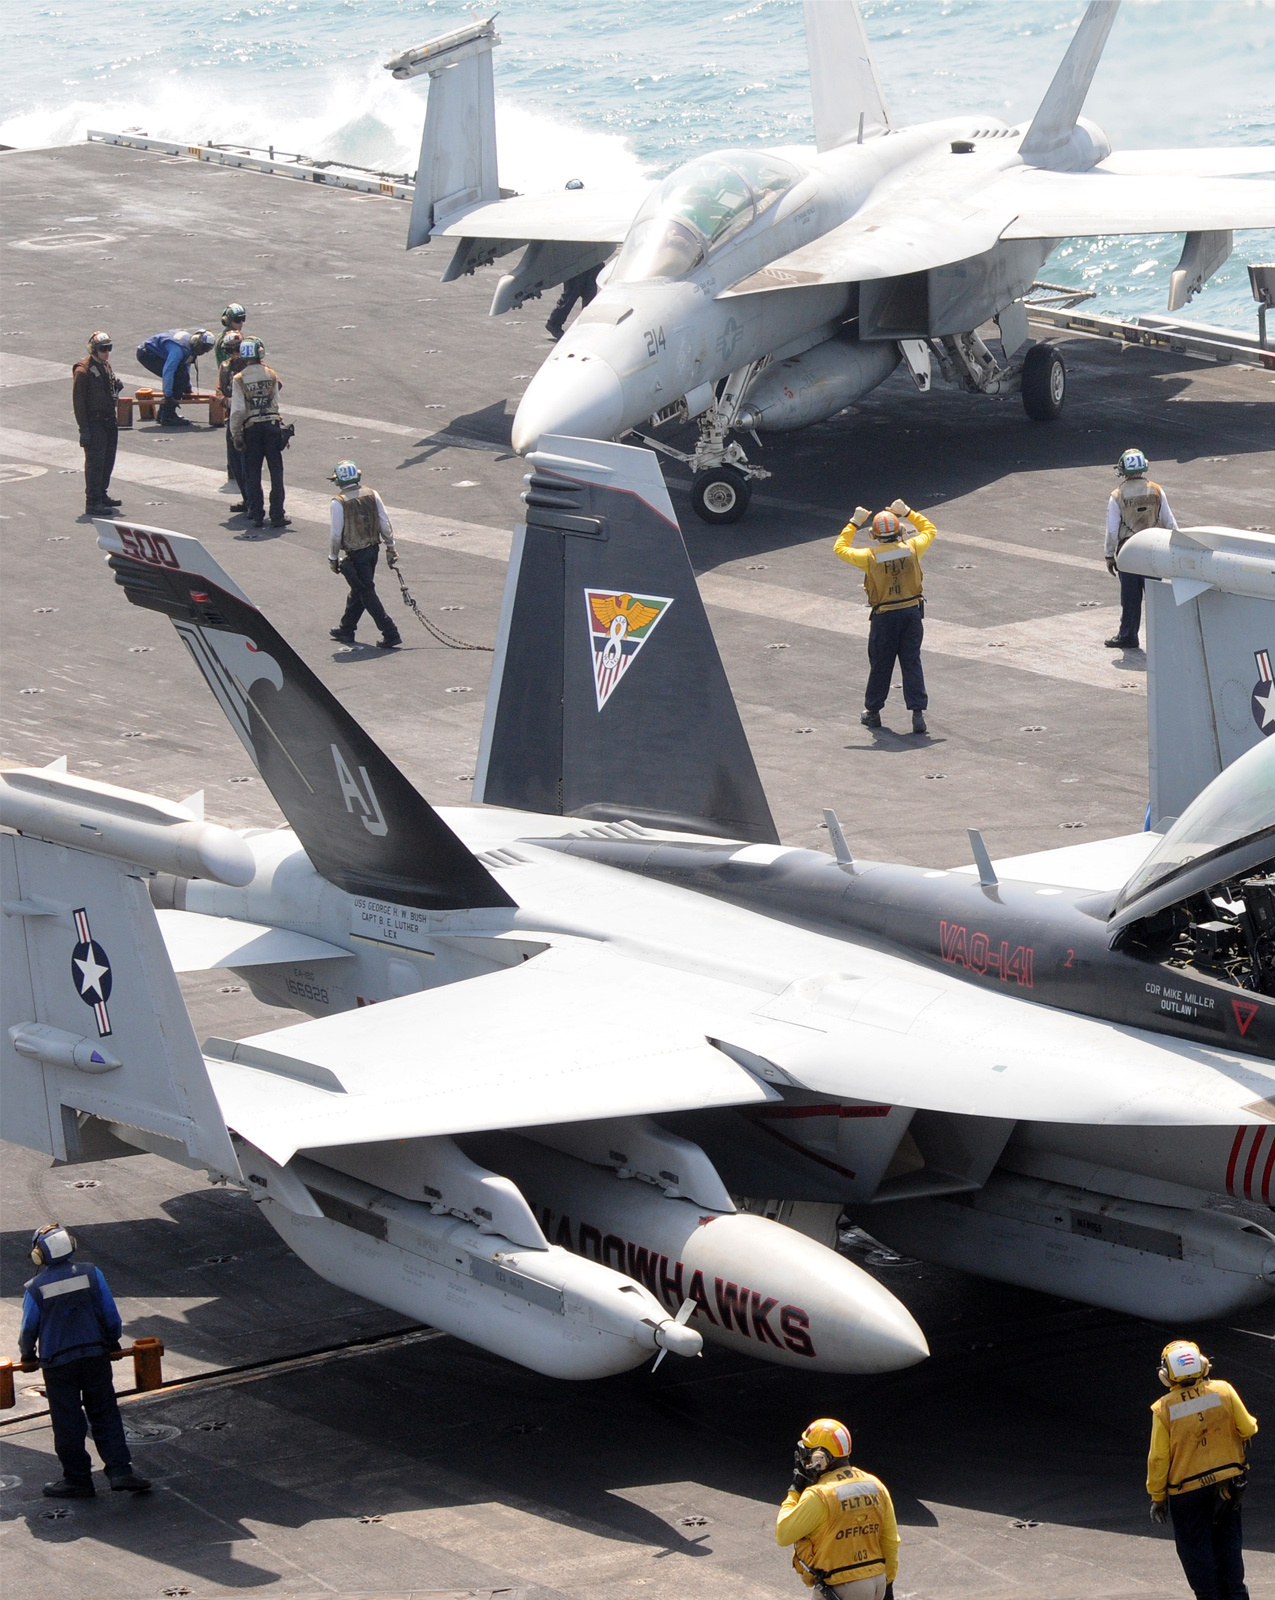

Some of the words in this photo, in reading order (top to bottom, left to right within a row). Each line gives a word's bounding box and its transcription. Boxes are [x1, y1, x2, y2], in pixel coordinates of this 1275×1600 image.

[643, 326, 666, 358] 214
[340, 465, 357, 479] 2D
[115, 525, 180, 569] 500
[884, 557, 906, 574] FLY
[330, 743, 388, 837] AJ
[355, 899, 366, 909] USS
[368, 902, 391, 915] GEORGE
[411, 912, 427, 923] BUSH
[362, 912, 377, 923] CAPT
[395, 921, 419, 933] LUTHER
[384, 929, 397, 940] LEX
[940, 921, 1033, 988] VAQ-141
[1064, 949, 1075, 967] 2
[286, 979, 329, 1005] 166928
[1145, 982, 1161, 995] CDR
[1163, 987, 1182, 1001] MIKE
[1184, 992, 1215, 1009] MILLER
[1160, 1000, 1192, 1016] OUTLAW
[1180, 1387, 1201, 1402] FLY
[1198, 1412, 1204, 1422] 3
[841, 1497, 861, 1511] FLT
[836, 1523, 880, 1540] OFFICER
